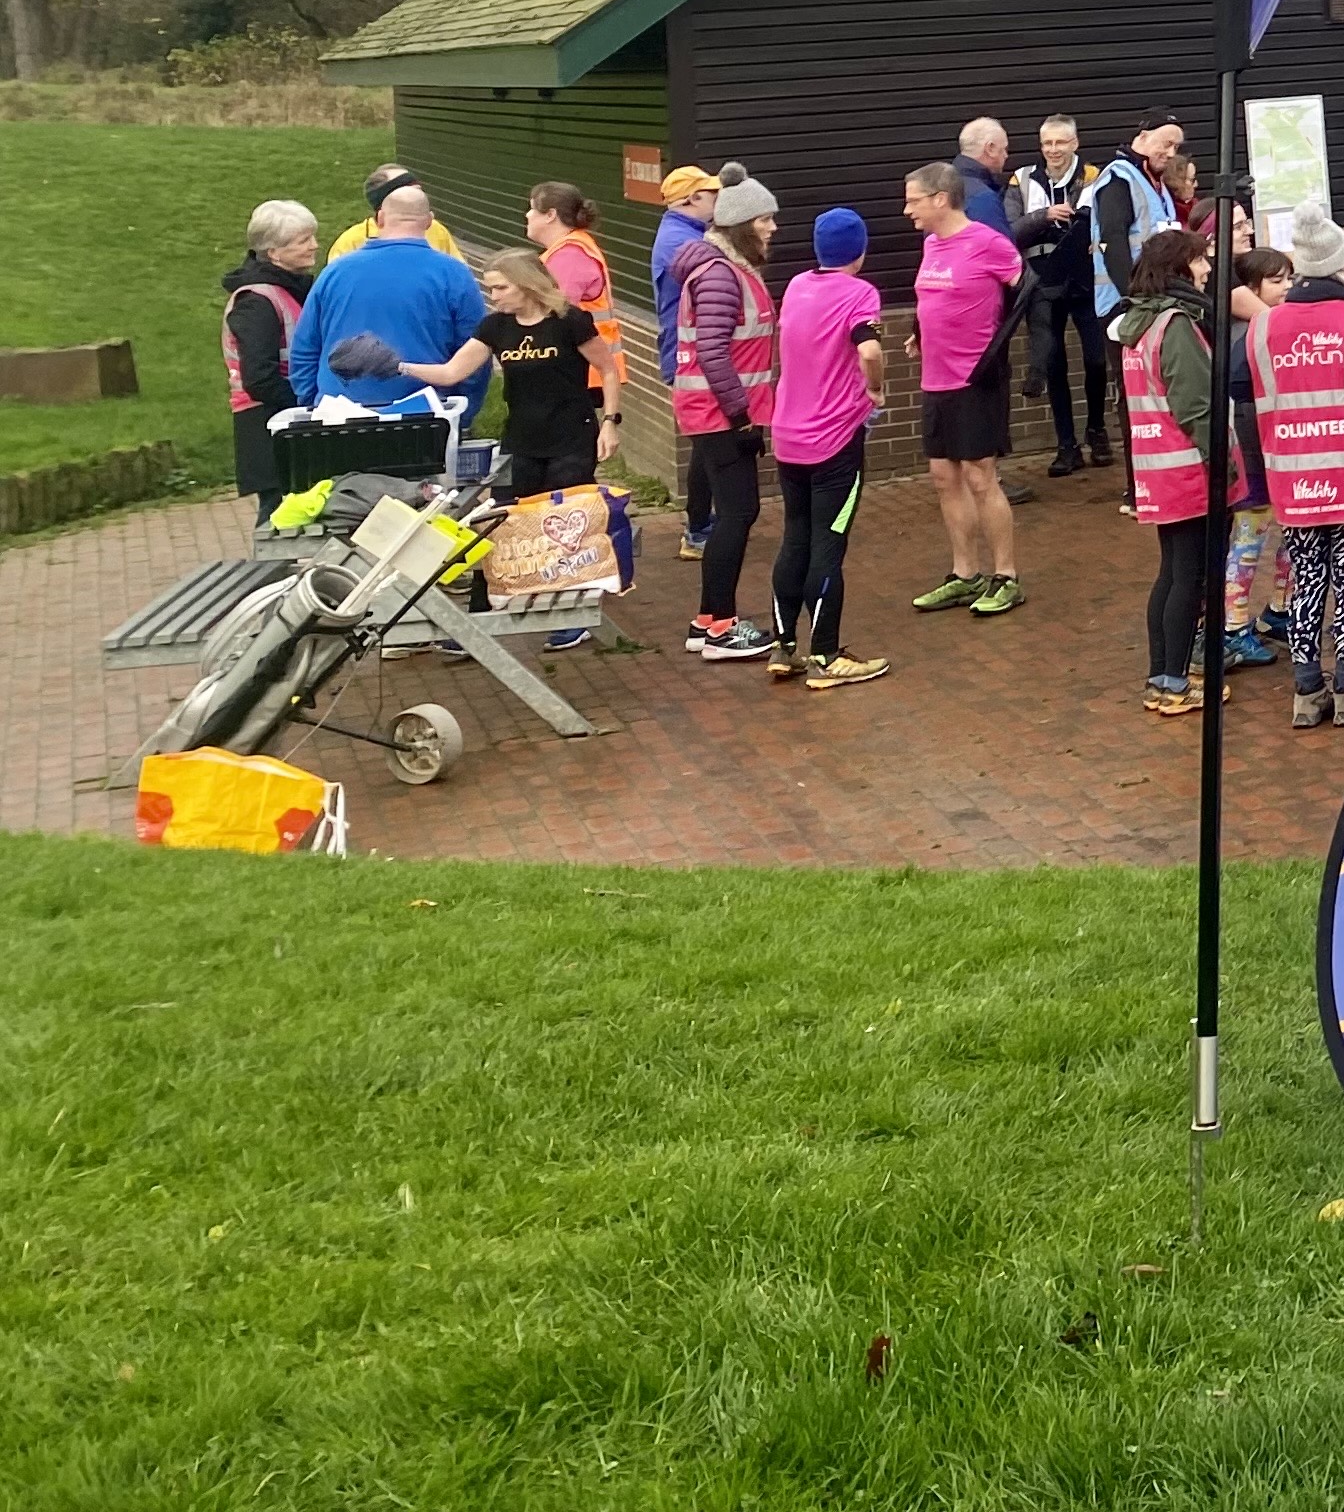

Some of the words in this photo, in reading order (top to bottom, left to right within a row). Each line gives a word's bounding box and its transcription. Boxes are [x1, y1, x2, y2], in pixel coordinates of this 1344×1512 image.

[500, 340, 558, 362] parkrun
[1272, 343, 1344, 372] parkrun
[1292, 477, 1338, 504] Vitality
